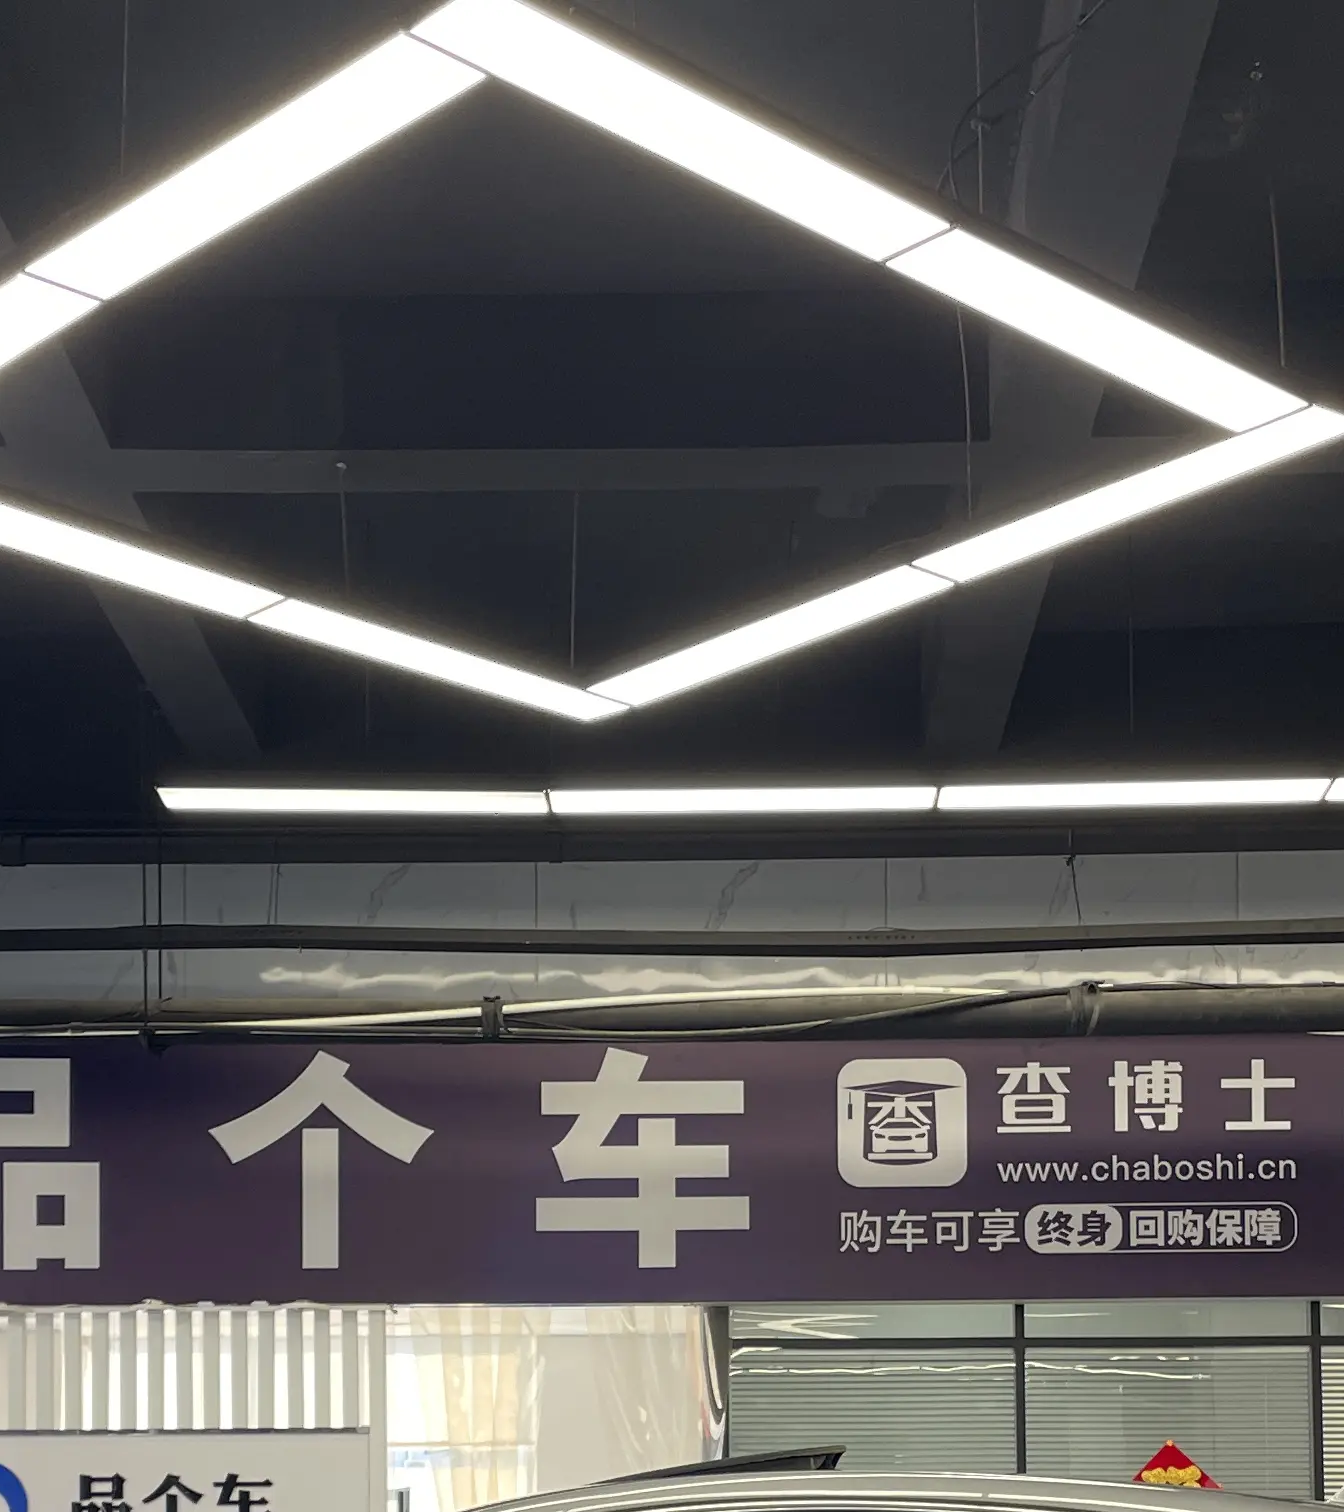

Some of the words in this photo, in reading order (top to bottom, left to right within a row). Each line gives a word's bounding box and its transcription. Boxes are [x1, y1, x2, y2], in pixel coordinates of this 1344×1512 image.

[996, 1059, 1296, 1133] 查博士
[997, 1153, 1297, 1183] www.chaboshi.cn
[839, 1208, 1282, 1253] 购车可享终身回购保障
